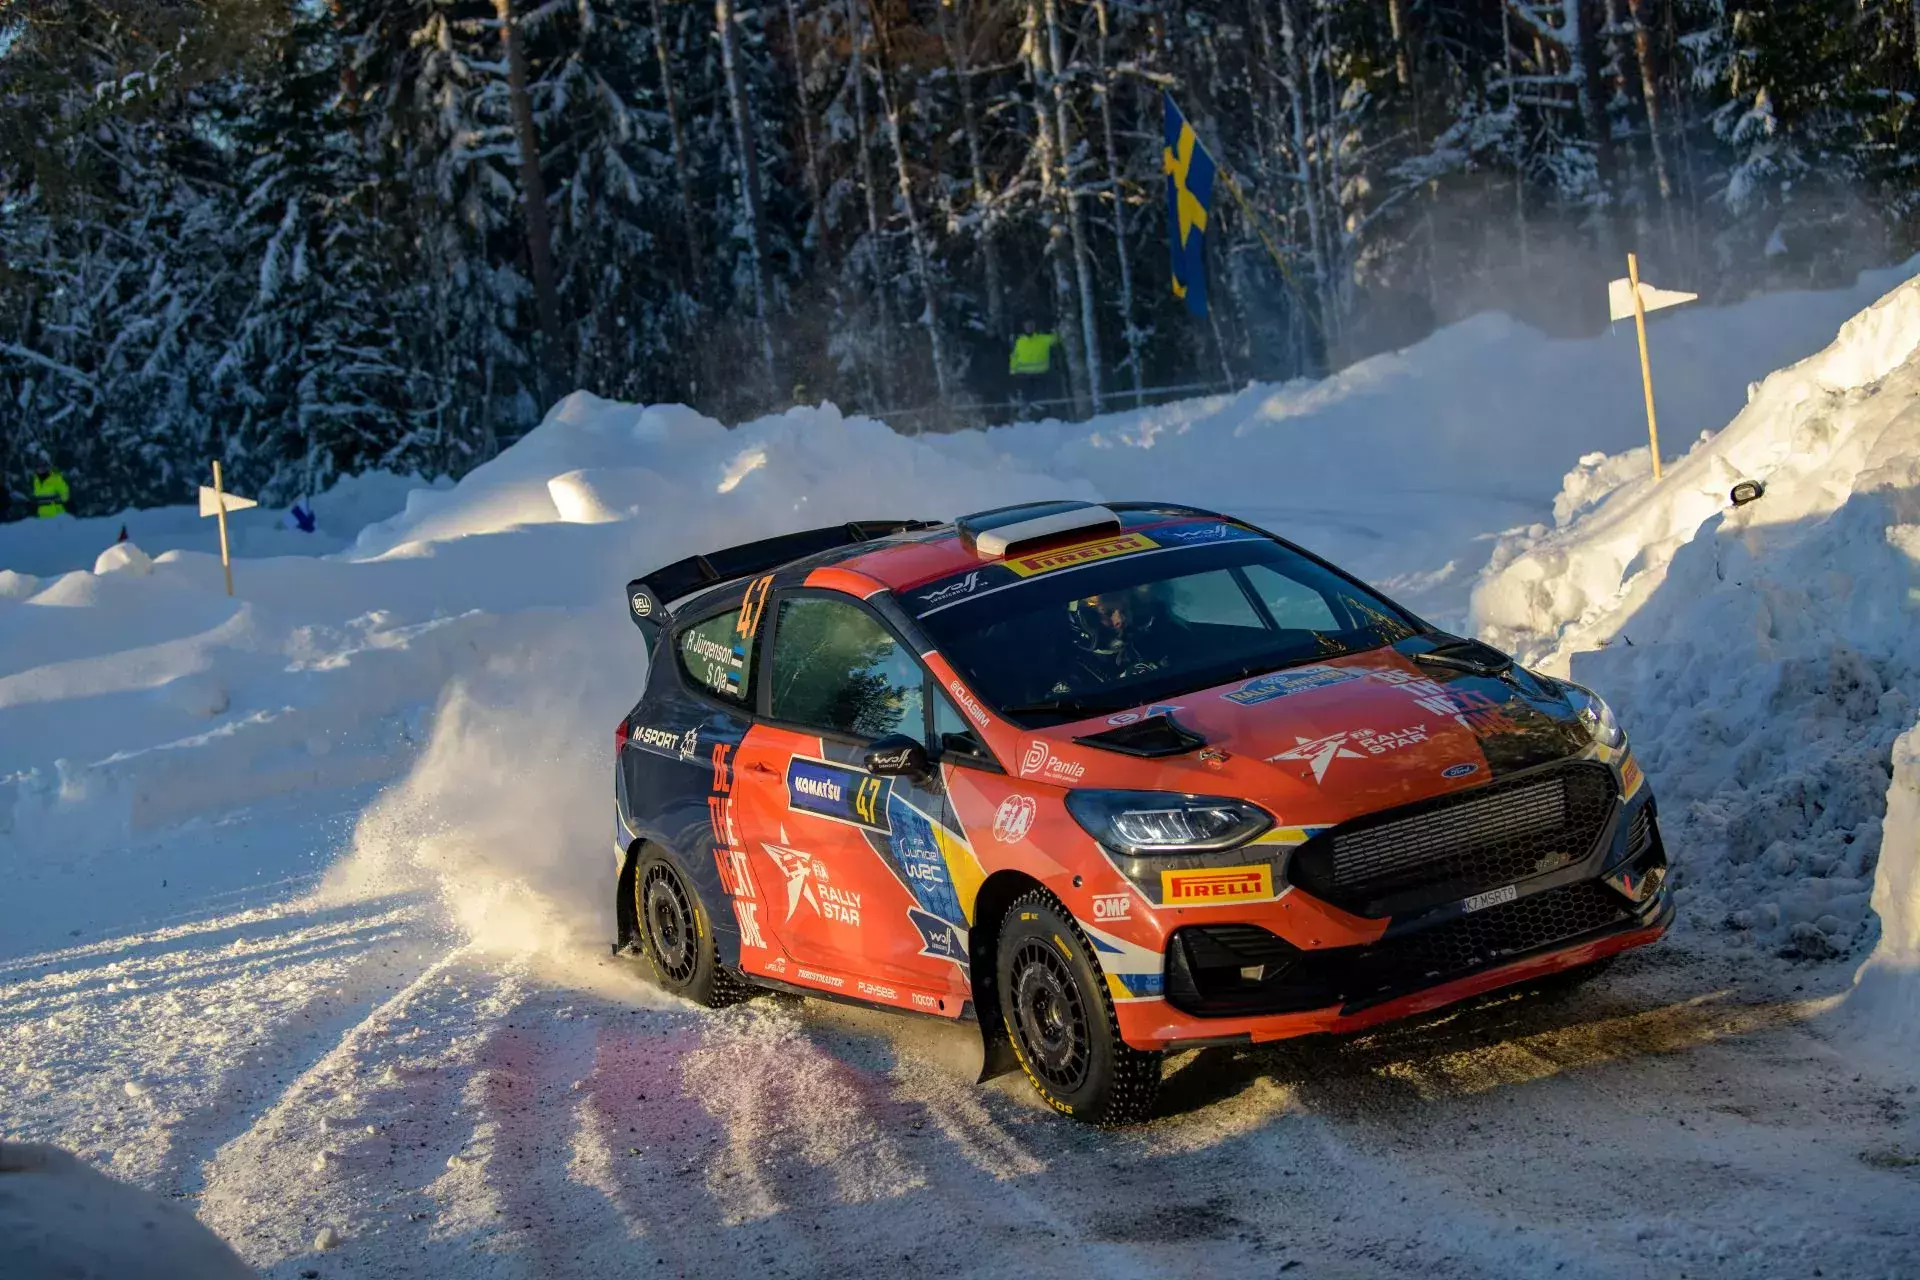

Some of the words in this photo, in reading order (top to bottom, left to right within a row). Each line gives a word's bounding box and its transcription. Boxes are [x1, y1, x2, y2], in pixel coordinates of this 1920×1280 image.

[1019, 536, 1143, 572] PIRELLI
[634, 597, 650, 609] BELL
[735, 574, 776, 640] 47
[686, 629, 696, 651] R
[693, 633, 732, 665] Jürgenson
[706, 662, 714, 684] S
[713, 665, 727, 693] Oja
[632, 725, 680, 750] M-SPORT
[1358, 724, 1427, 748] RALLY
[1368, 732, 1429, 754] STAR
[712, 743, 731, 792] BE
[1046, 756, 1086, 777] Panila
[795, 776, 841, 801] KOMATSU
[855, 776, 881, 824] 47
[995, 802, 1030, 836] FIA
[904, 861, 944, 884] WRC
[1171, 872, 1262, 898] PIRELLI
[817, 884, 862, 909] RALLY
[1092, 899, 1131, 917] OMP
[823, 903, 860, 927] STAR
[911, 992, 937, 1009] nacon
